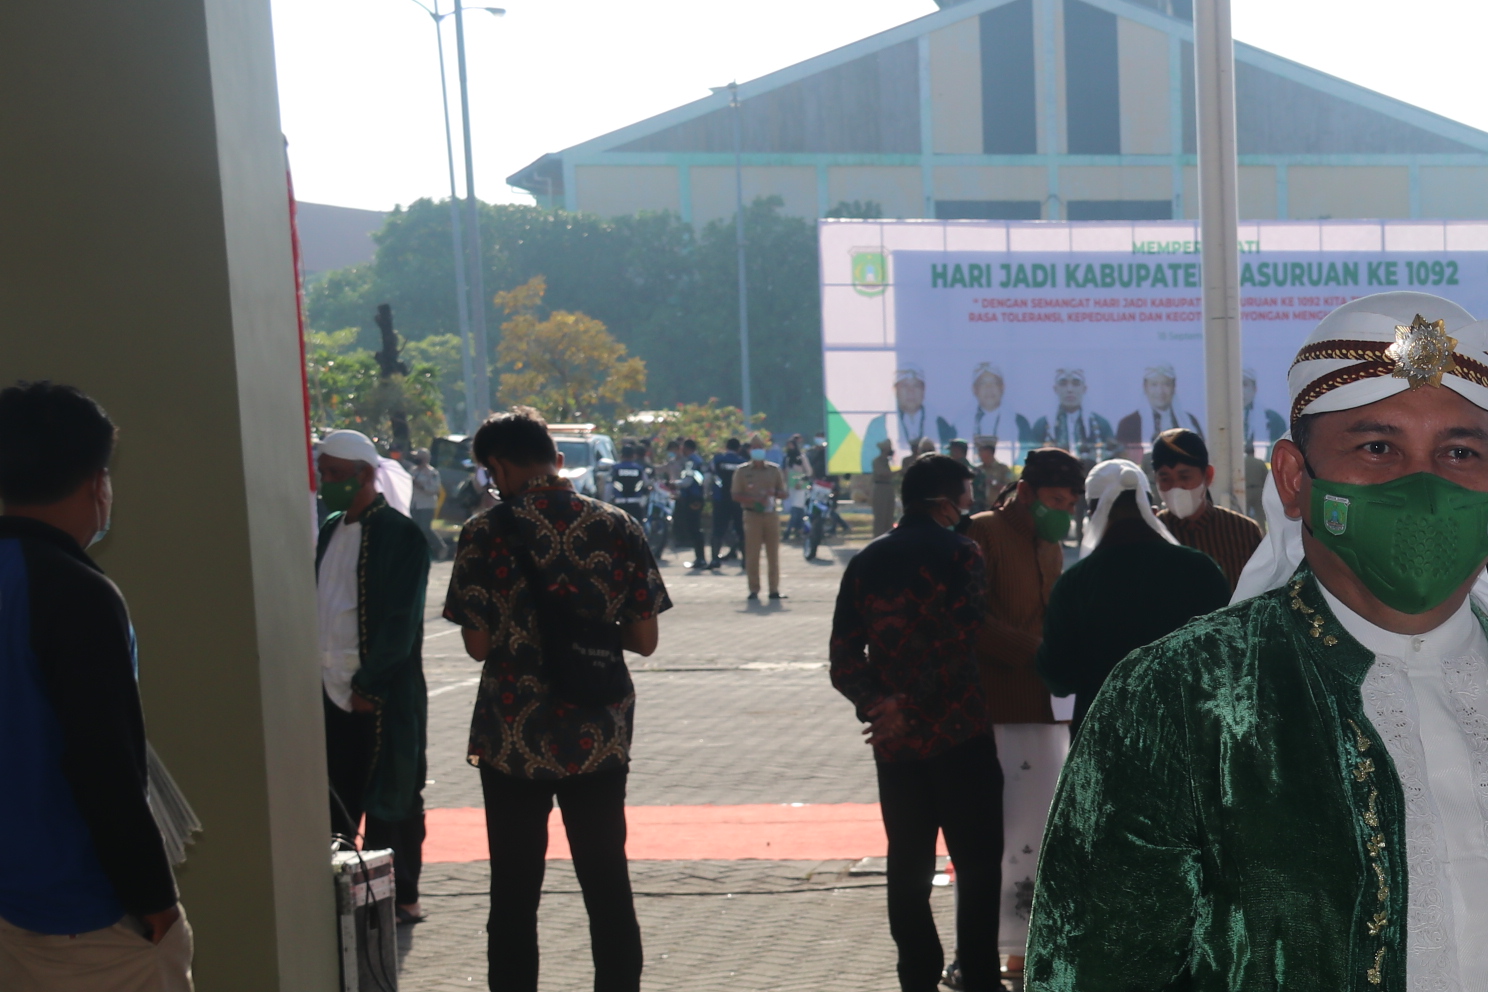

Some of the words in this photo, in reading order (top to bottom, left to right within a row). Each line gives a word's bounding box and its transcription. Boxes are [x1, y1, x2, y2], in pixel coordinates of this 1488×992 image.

[931, 263, 992, 288] HARI
[999, 263, 1056, 288] JADI
[1065, 263, 1203, 288] KABUPATE
[1240, 261, 1359, 287] ASURUAN
[1367, 261, 1398, 286] KE
[1405, 260, 1459, 286] 1092
[1031, 298, 1090, 308] SEMANGAT
[1093, 298, 1119, 308] HARI
[1123, 298, 1147, 308] JADI
[1281, 297, 1294, 307] KE
[968, 312, 998, 322] RASA
[1139, 312, 1162, 322] DAN
